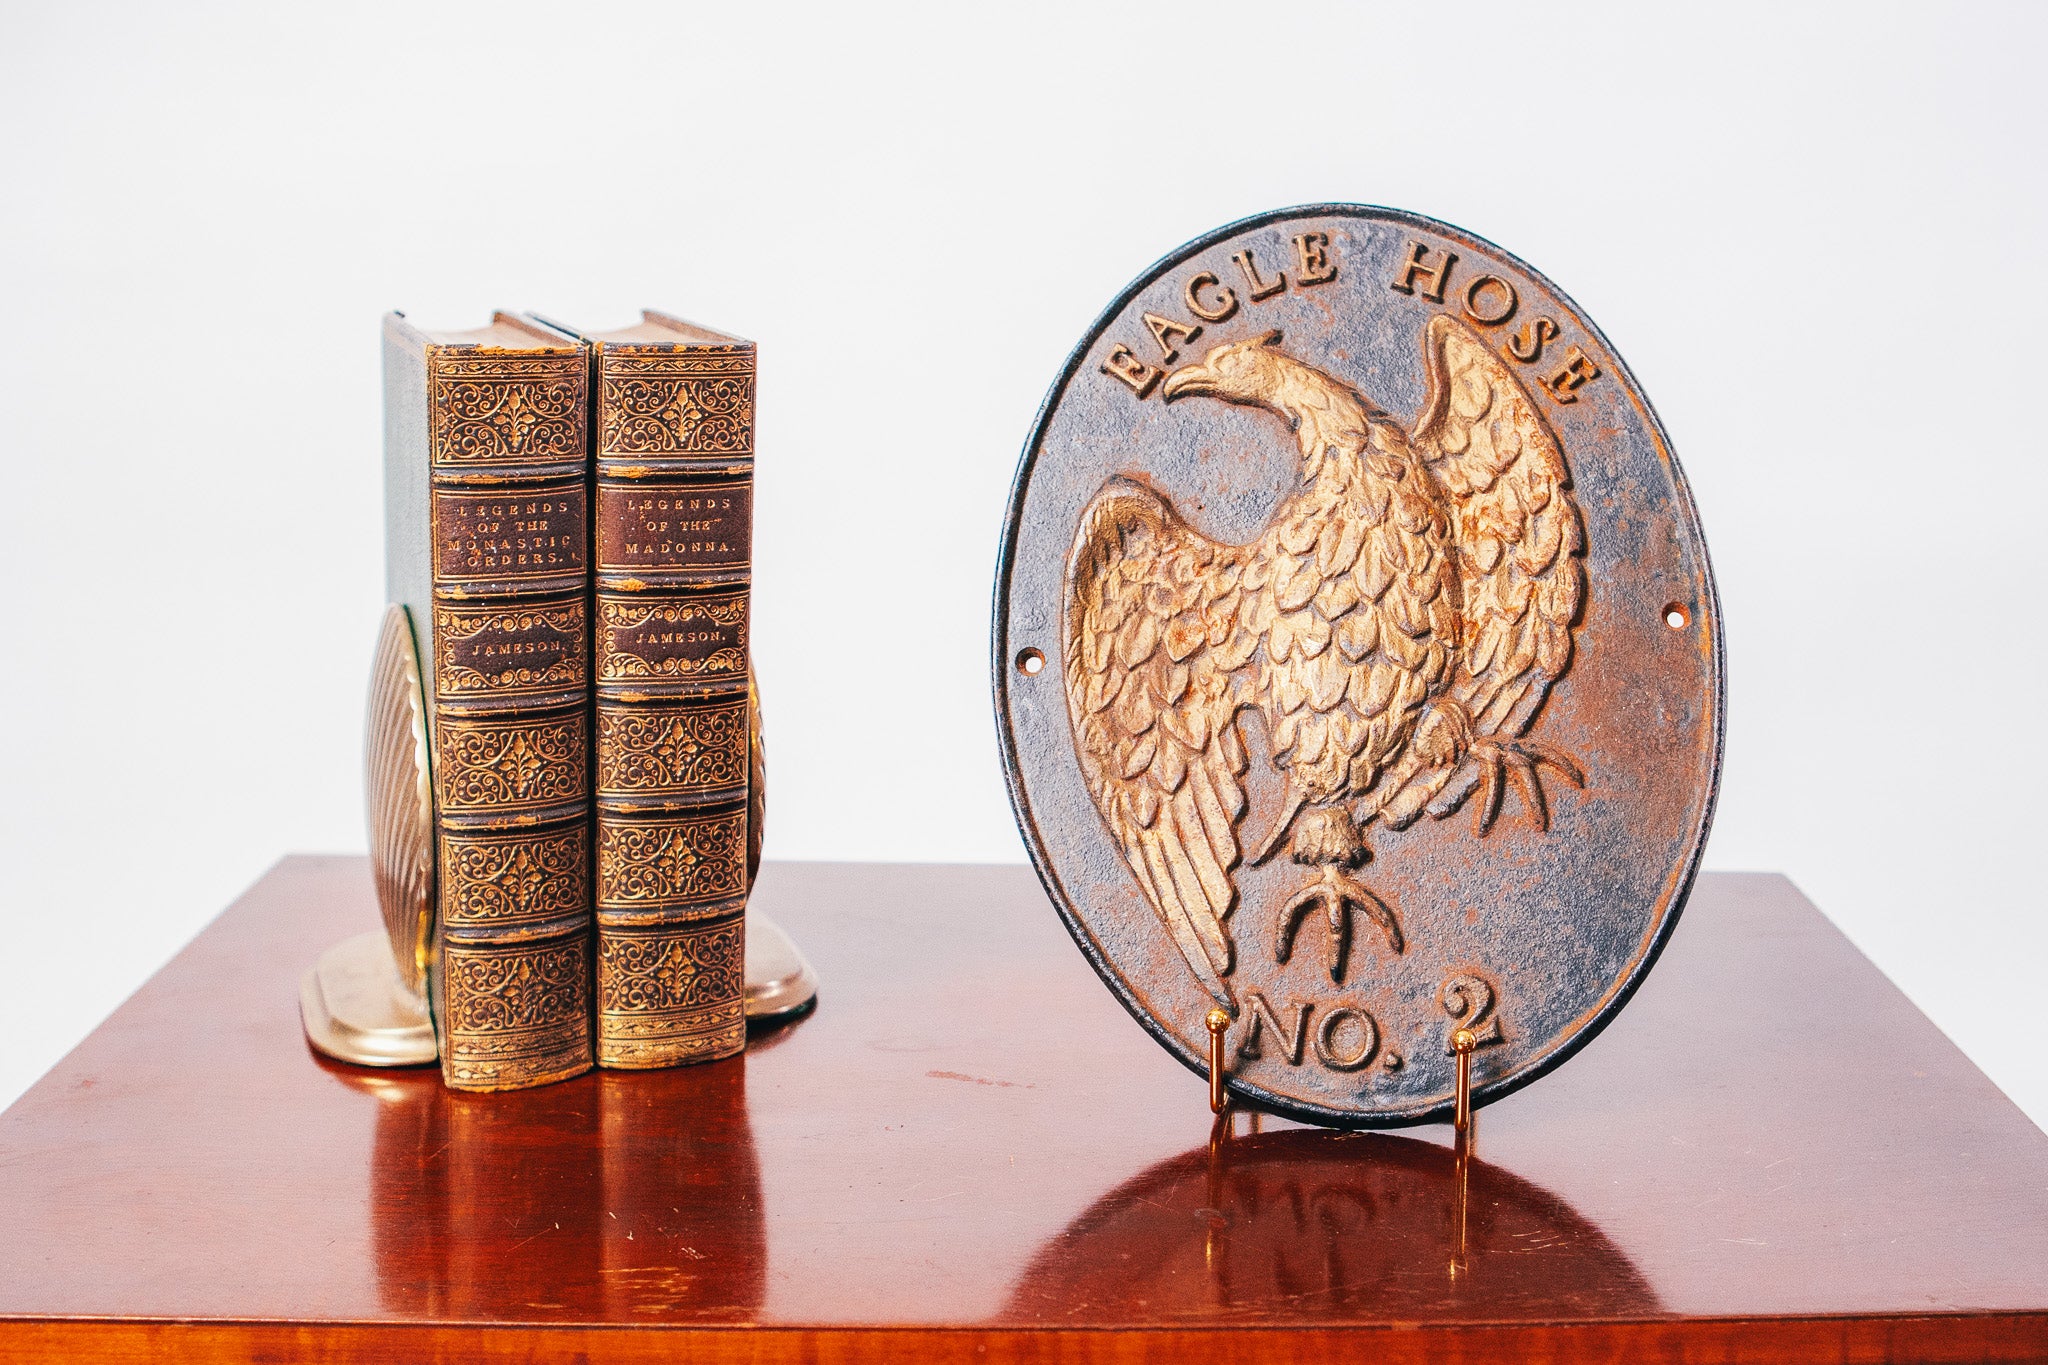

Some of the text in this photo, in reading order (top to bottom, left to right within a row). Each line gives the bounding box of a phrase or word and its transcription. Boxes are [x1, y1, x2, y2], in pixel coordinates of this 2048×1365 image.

[1101, 232, 1602, 403] EAGLE HOSE
[459, 502, 568, 516] LEGENDS
[627, 499, 730, 510] LEGENDS
[477, 521, 548, 533] OF THE
[646, 520, 711, 531] OF THE
[447, 535, 570, 551] MONASTIC
[625, 542, 736, 554] MADONNA.
[636, 631, 726, 645] JAMESON.
[1238, 974, 1504, 1073] NO. 2
